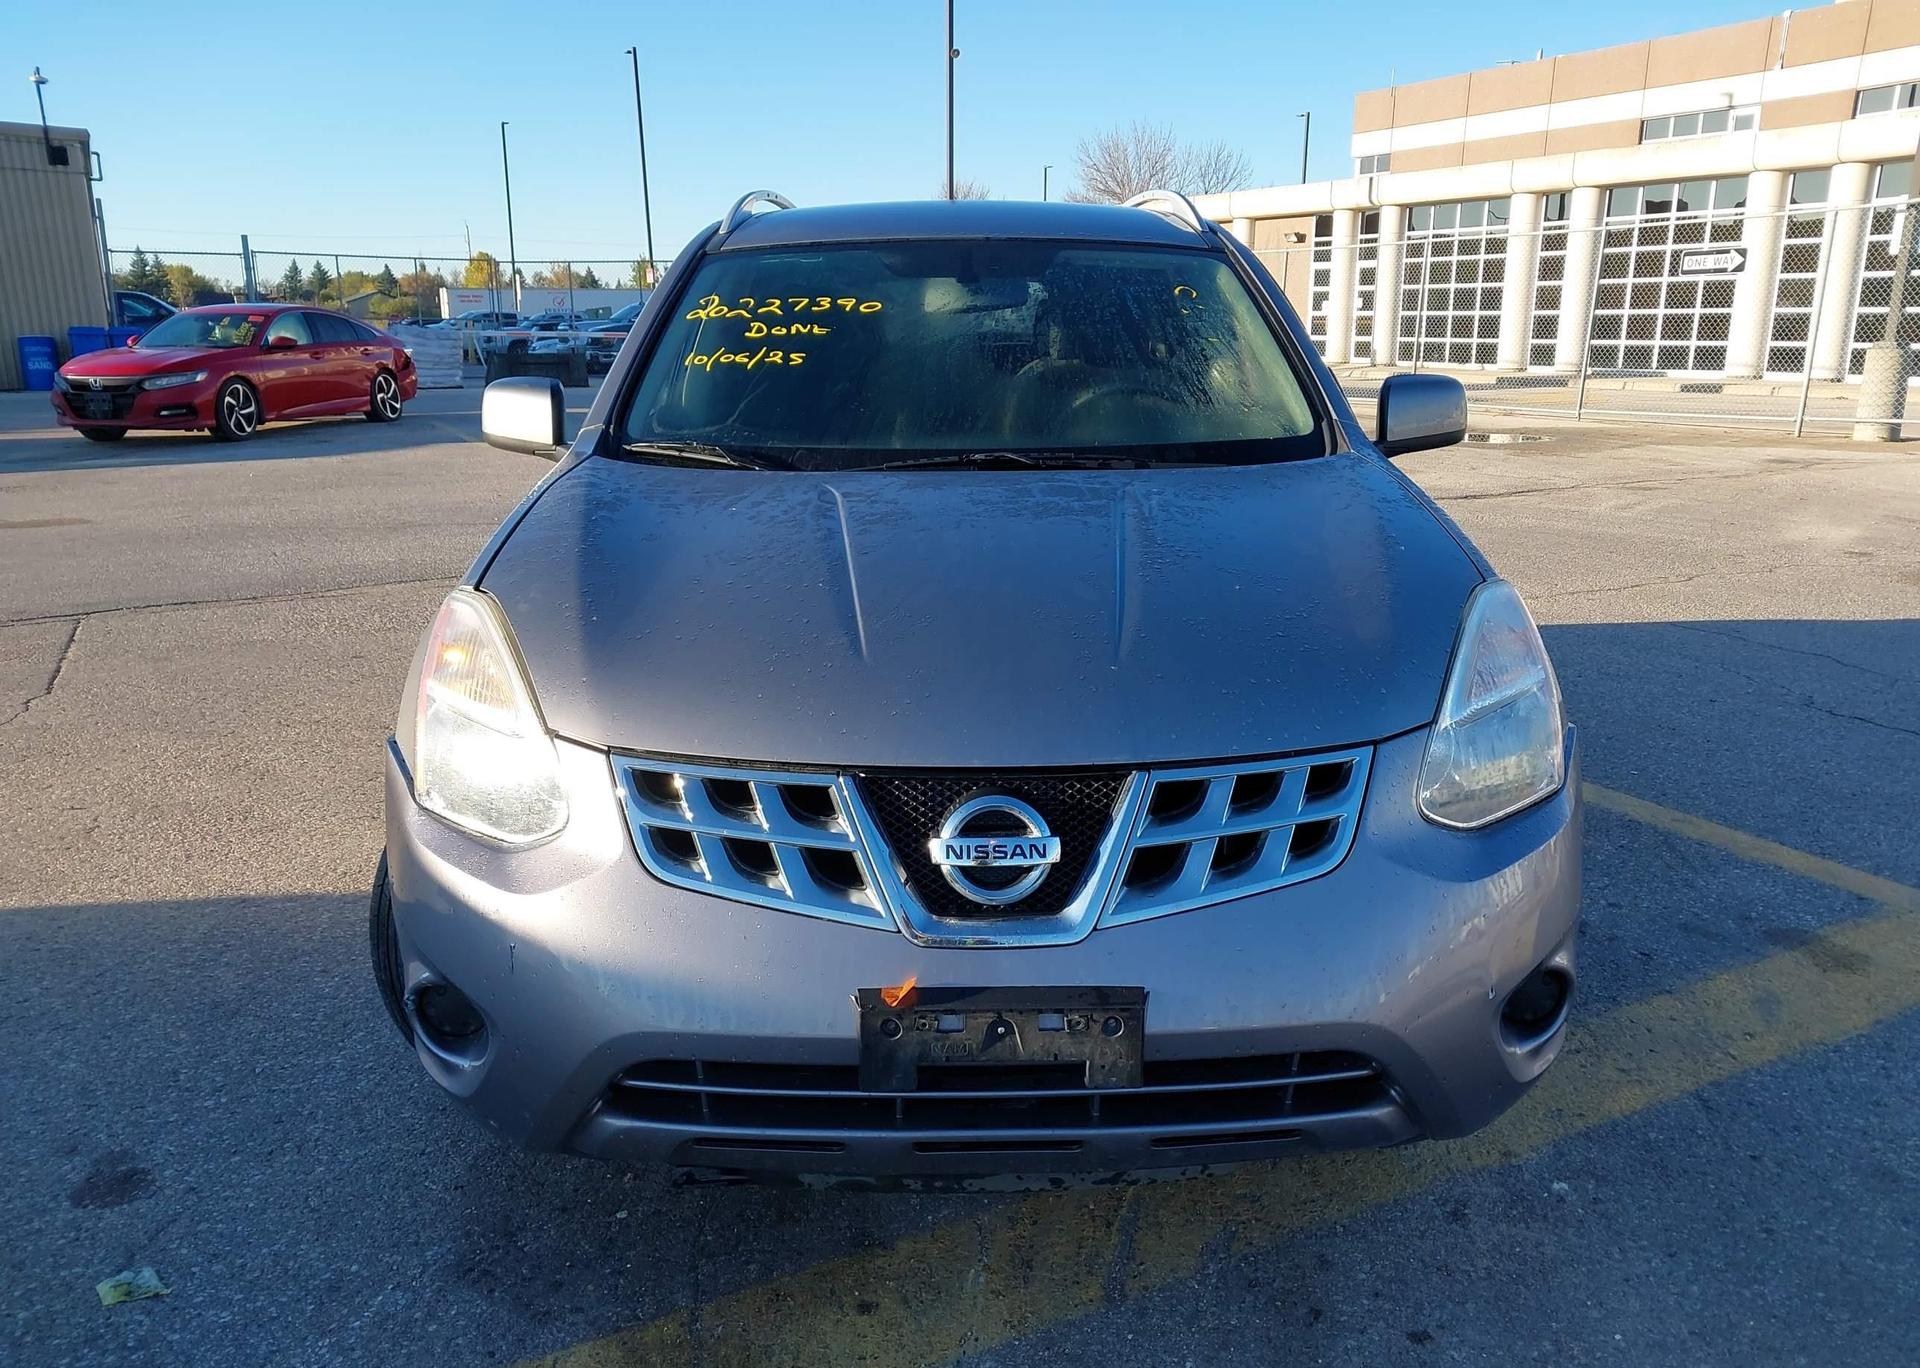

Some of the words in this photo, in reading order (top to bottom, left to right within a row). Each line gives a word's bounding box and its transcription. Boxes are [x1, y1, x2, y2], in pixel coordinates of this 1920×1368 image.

[1687, 257, 1709, 268] ONE
[1713, 256, 1736, 266] WAY
[744, 321, 832, 338] DONE
[27, 361, 53, 370] SAND
[684, 347, 806, 371] 10/06/25
[945, 843, 1047, 860] NISSAN
